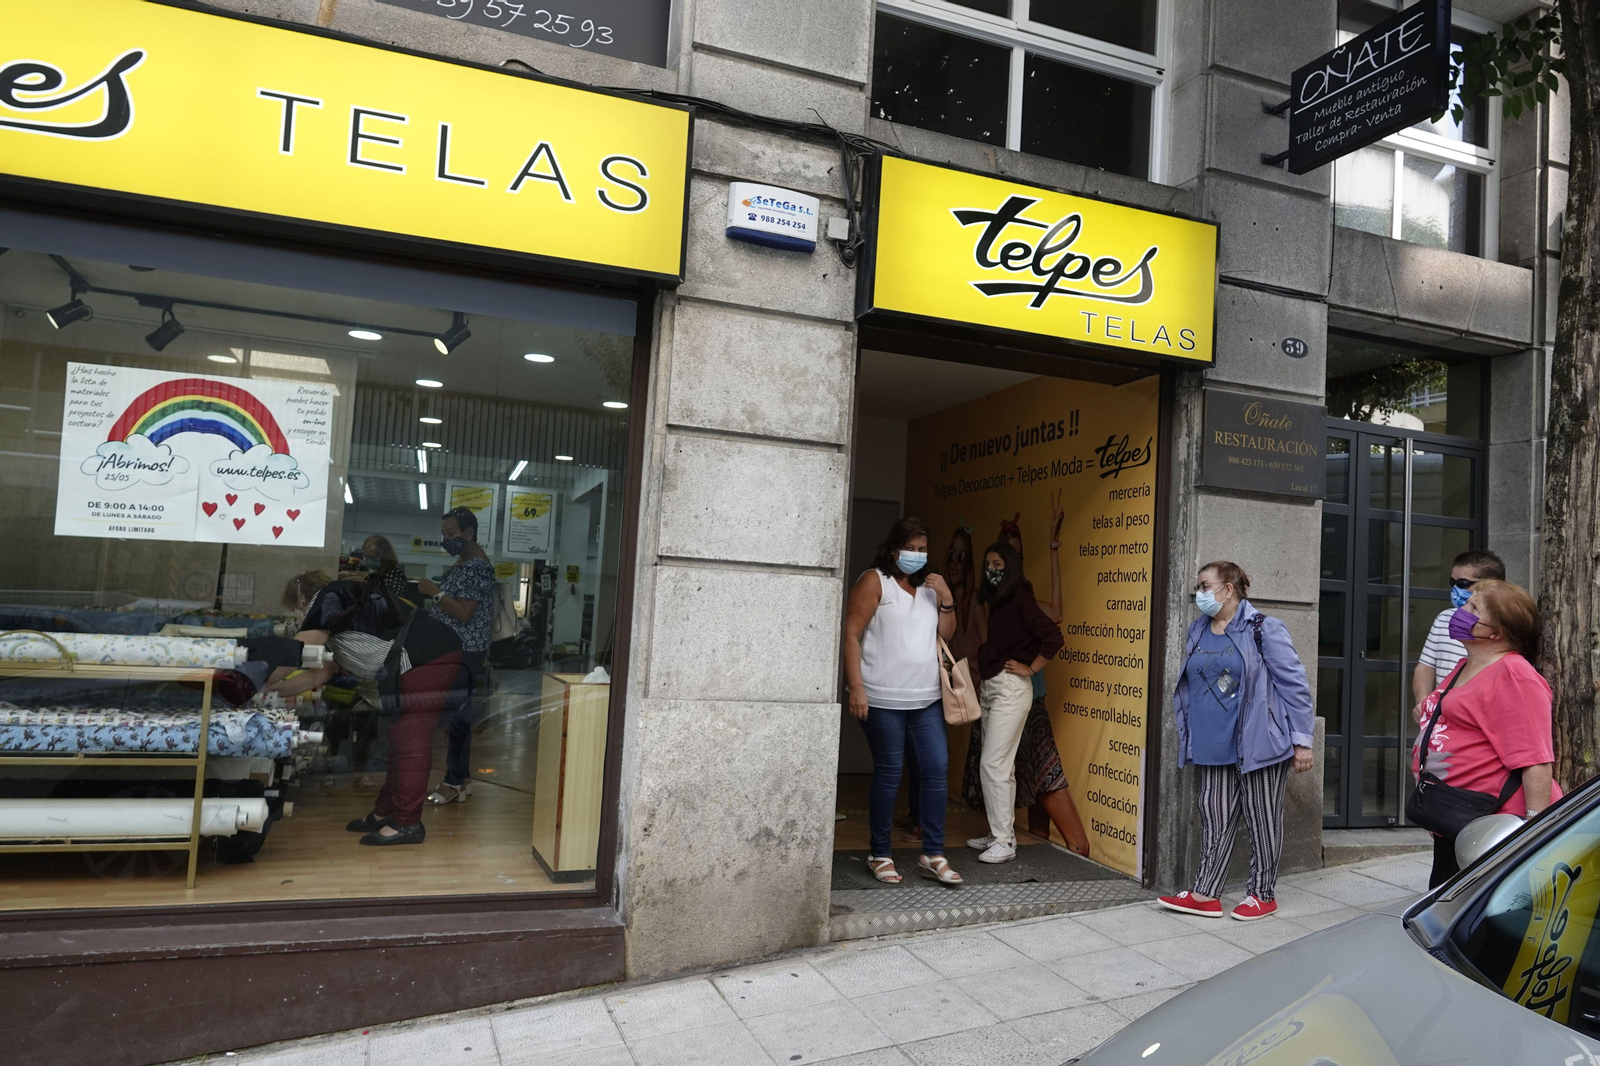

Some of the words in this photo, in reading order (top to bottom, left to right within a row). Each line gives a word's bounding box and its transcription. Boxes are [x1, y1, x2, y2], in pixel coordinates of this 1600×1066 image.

[483, 0, 526, 27] 57
[533, 9, 575, 34] 25
[569, 19, 614, 47] 93
[1300, 11, 1424, 104] OÑATE
[1314, 94, 1353, 121] Mueble
[1356, 69, 1405, 101] antiguo
[1295, 124, 1327, 145] Taller
[1329, 115, 1341, 130] de
[1345, 75, 1428, 122] Restauración
[1366, 103, 1402, 127] Venta
[258, 89, 648, 214] TELAS
[756, 195, 797, 212] SeTeGa
[798, 206, 814, 216] S.L.
[760, 214, 775, 224] 988
[776, 217, 791, 227] 254
[792, 221, 806, 230] 254
[953, 195, 1158, 309] telpes
[1080, 310, 1197, 351] TELAS
[70, 365, 93, 375] ¿Has
[94, 367, 117, 376] hecho
[71, 376, 79, 384] la
[80, 376, 97, 385] lista
[70, 388, 110, 397] materiales
[285, 397, 309, 405] puedes
[309, 397, 329, 406] hacer
[69, 399, 89, 407] para
[90, 399, 103, 407] tus
[305, 408, 327, 417] pedido
[68, 409, 105, 419] proyectos
[106, 411, 115, 419] de
[68, 419, 103, 428] costura?
[1243, 401, 1293, 431] Oñate
[286, 428, 292, 436] y
[293, 428, 318, 437] recoger
[305, 438, 327, 446] tienda
[950, 442, 966, 465] De
[969, 433, 1012, 460] nuevo
[1013, 419, 1065, 457] juntas
[1214, 430, 1318, 457] RESTAURACIÓN
[96, 453, 175, 473] ¡Abrimos!
[1228, 456, 1240, 465] 986
[1240, 457, 1252, 466] 423
[1253, 459, 1264, 468] 171
[1269, 461, 1281, 469] 639
[1281, 463, 1292, 472] 572
[104, 471, 130, 482] 25/05
[216, 465, 301, 482] www.telpes.es
[934, 483, 957, 500] Telpes
[958, 472, 1006, 494] Decoración
[1008, 474, 1015, 484] +
[1017, 465, 1048, 486] Telpes
[1050, 455, 1083, 478] Moda
[1085, 459, 1095, 469] =
[1109, 482, 1151, 501] mercería
[1291, 482, 1308, 492] Local
[1310, 485, 1318, 493] 17
[87, 501, 101, 509] DE
[104, 502, 126, 510] 9:00
[138, 504, 164, 512] 14:00
[133, 512, 162, 520] SÁBADO
[1092, 514, 1113, 529] telas
[1115, 512, 1124, 527] al
[1126, 513, 1150, 530] peso
[1079, 542, 1099, 557] telas
[1101, 544, 1117, 559] por
[1119, 541, 1149, 555] metro
[1097, 567, 1148, 586] patchwork
[1106, 596, 1147, 611] carnaval
[1067, 621, 1114, 638] confección
[1116, 623, 1146, 644] hogar
[1059, 646, 1090, 664] objetos
[1092, 649, 1144, 669] decoración
[1069, 676, 1104, 693] cortinas
[1106, 682, 1112, 697] y
[1113, 682, 1143, 699] stores
[1063, 701, 1089, 717] stores
[1090, 707, 1142, 728] enrollables
[1108, 739, 1141, 757] screen
[1088, 762, 1139, 787] confección
[1087, 789, 1138, 816] colocación
[1091, 817, 1137, 846] tapizados
